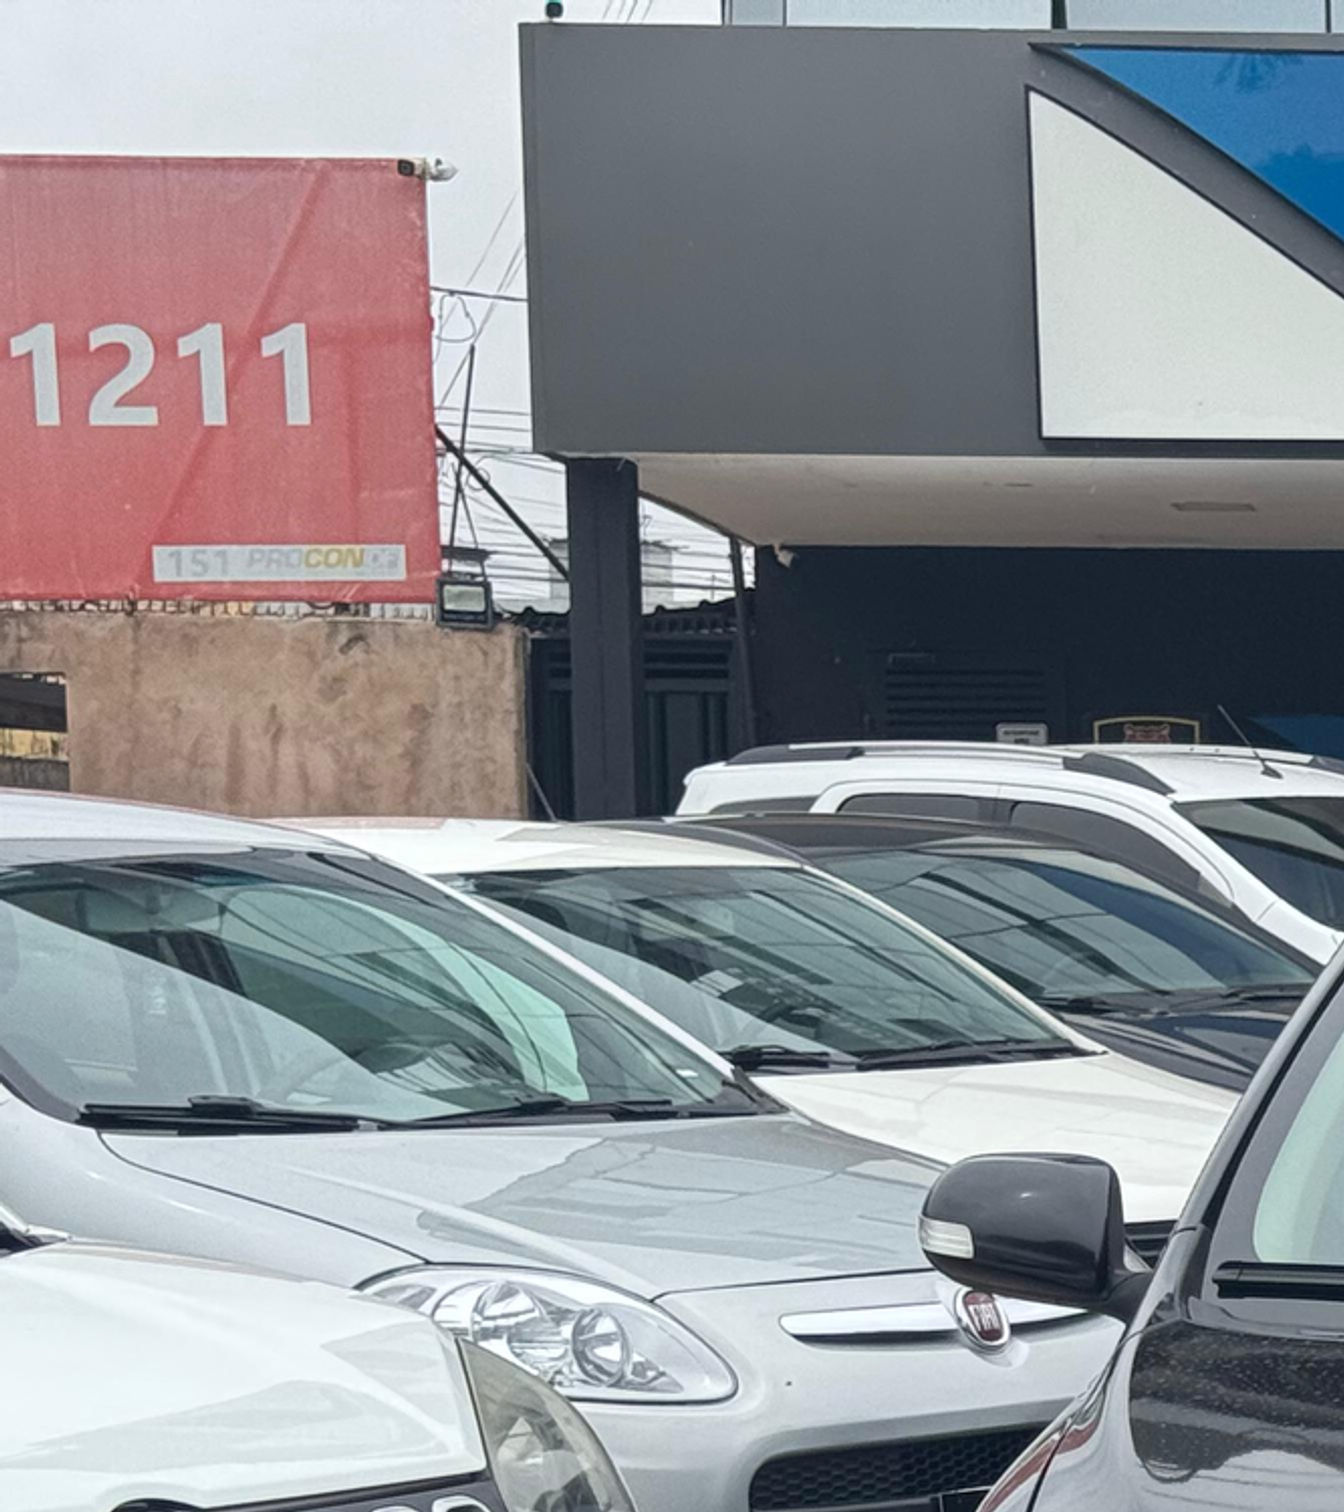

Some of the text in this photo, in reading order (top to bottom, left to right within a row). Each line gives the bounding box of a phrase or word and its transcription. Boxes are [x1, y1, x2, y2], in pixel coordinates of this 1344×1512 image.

[9, 321, 312, 427] 1211
[168, 550, 229, 578] 151
[248, 548, 366, 568] PROCON
